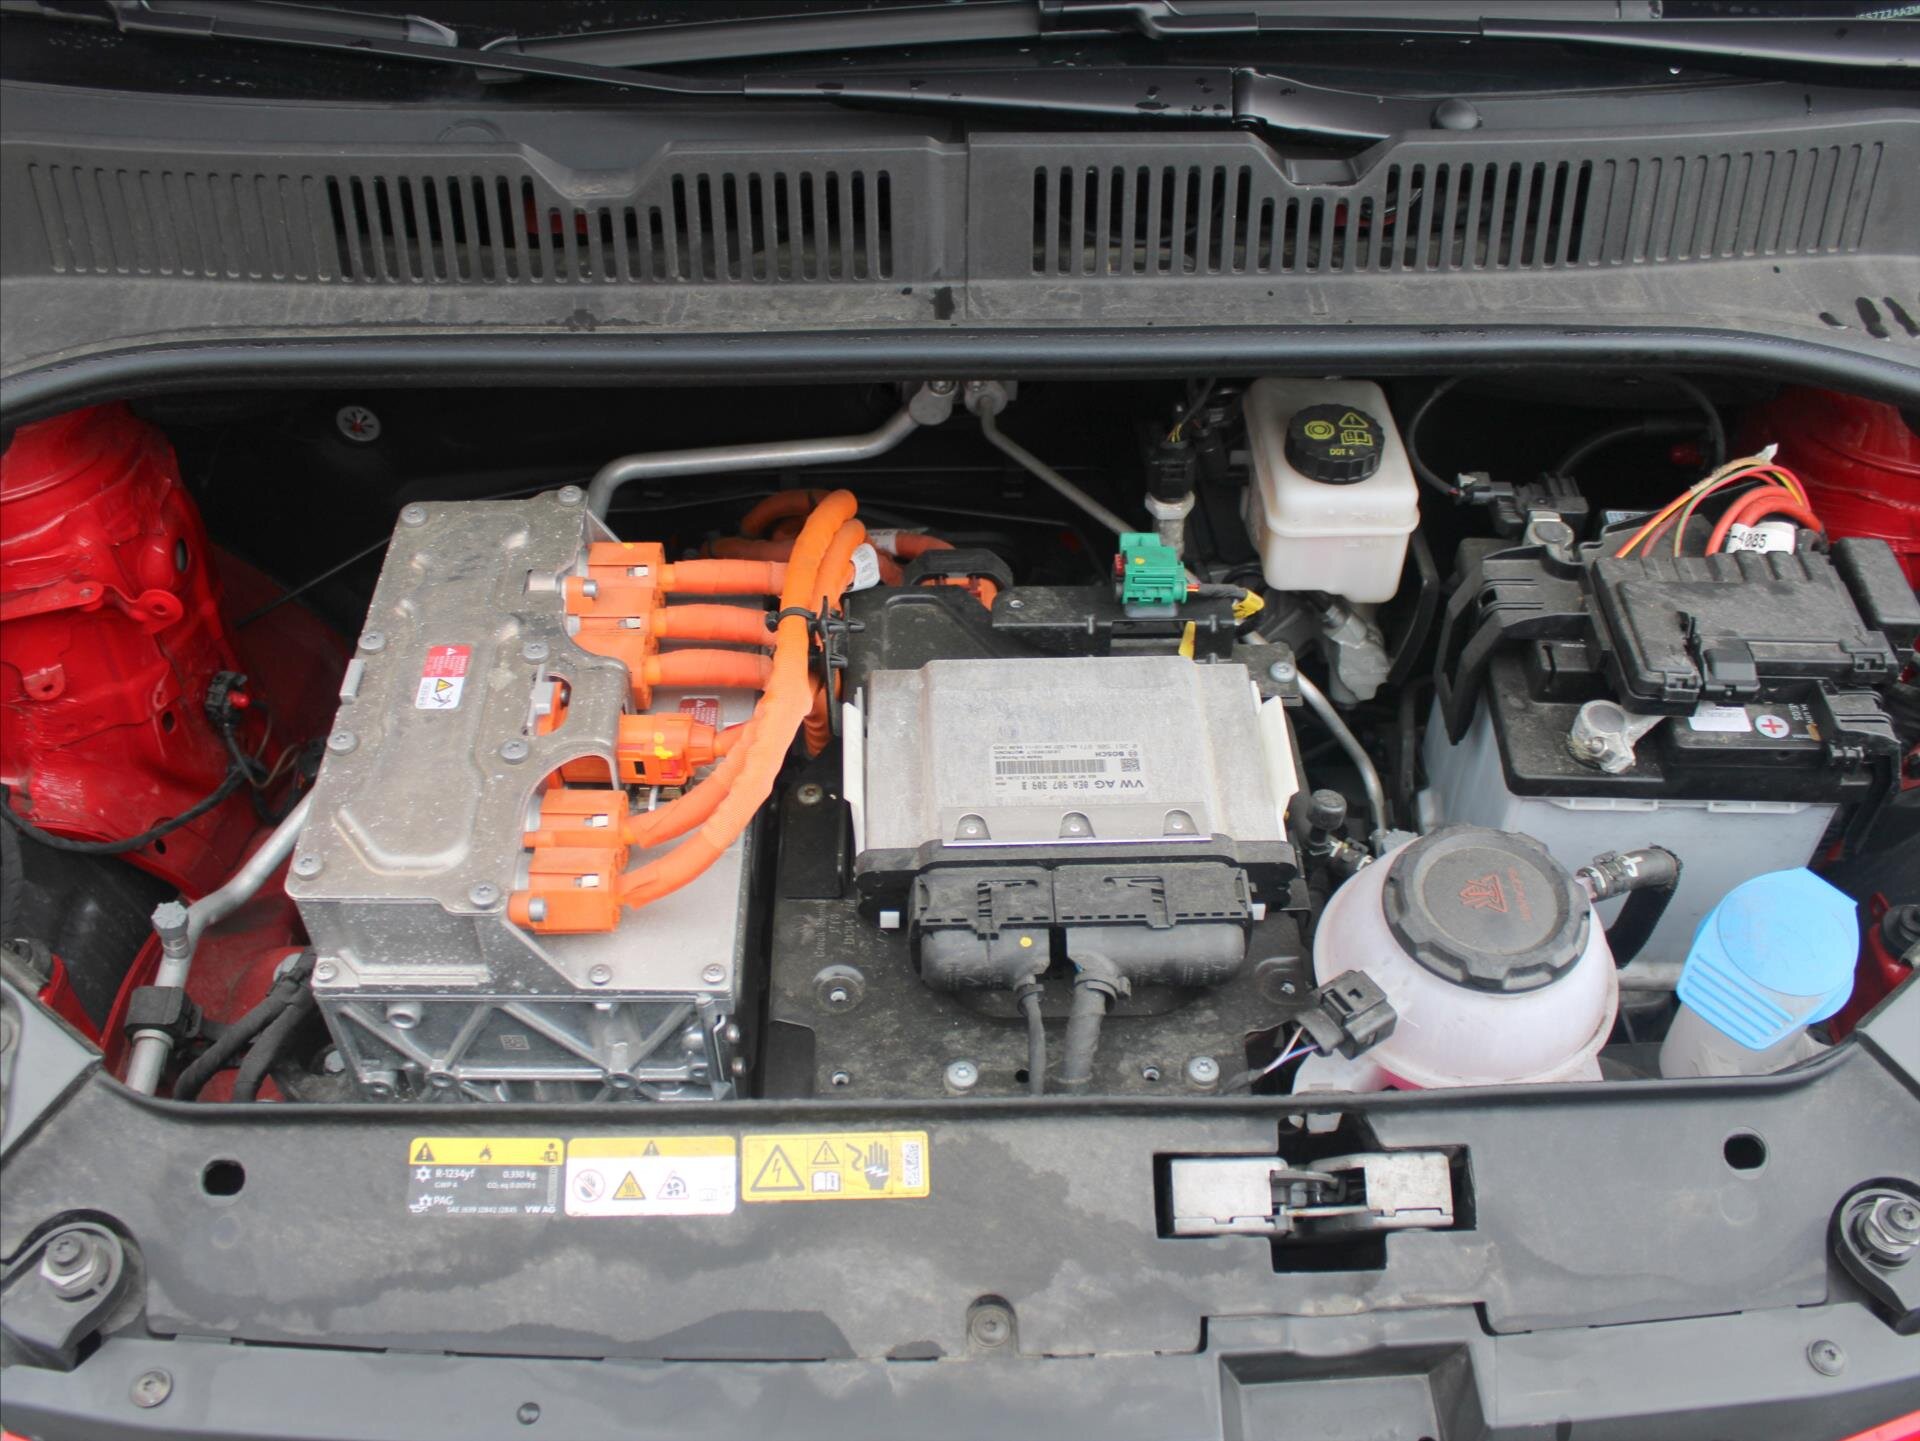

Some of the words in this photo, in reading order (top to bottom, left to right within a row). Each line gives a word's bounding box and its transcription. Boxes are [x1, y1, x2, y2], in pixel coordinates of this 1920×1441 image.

[1329, 448, 1346, 456] DOT
[1094, 780, 1116, 789] AG
[1120, 779, 1144, 788] VW
[434, 1168, 476, 1181] R-1234yf
[525, 1171, 537, 1181] kg
[433, 1195, 455, 1205] PAG
[524, 1205, 541, 1214] VW
[541, 1205, 557, 1213] AG
